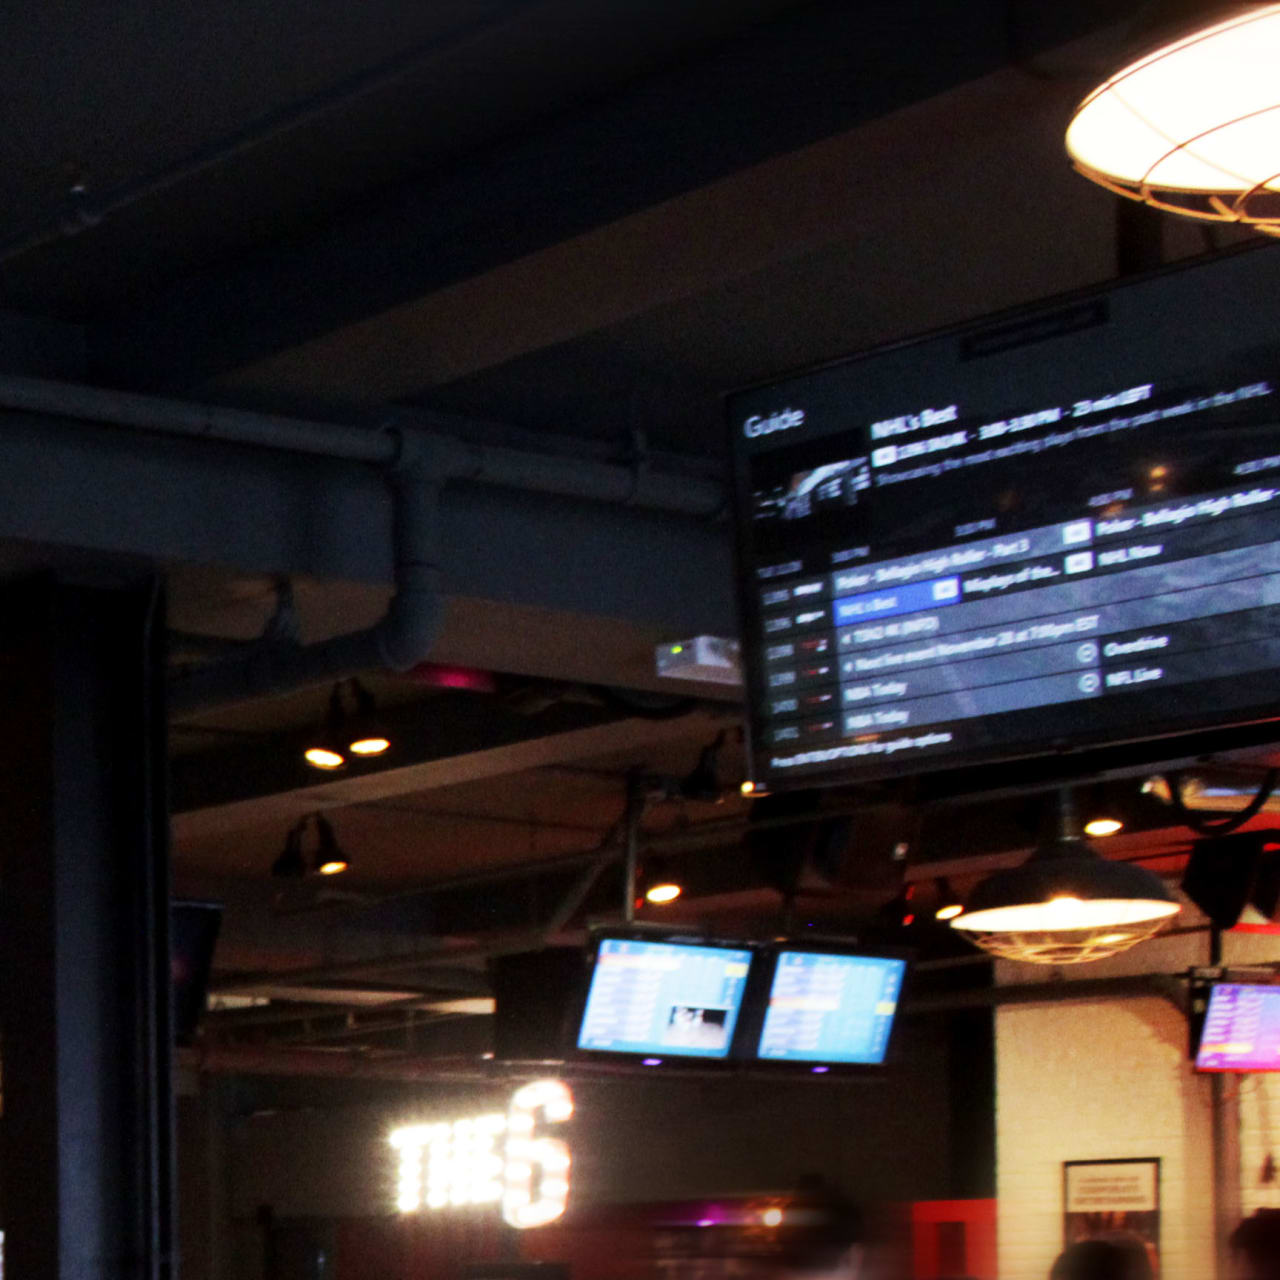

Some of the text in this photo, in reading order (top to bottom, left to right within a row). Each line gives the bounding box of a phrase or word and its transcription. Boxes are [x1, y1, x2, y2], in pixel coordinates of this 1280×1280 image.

[744, 406, 807, 438] Guide
[920, 404, 959, 428] Best
[503, 1078, 574, 1229] 6
